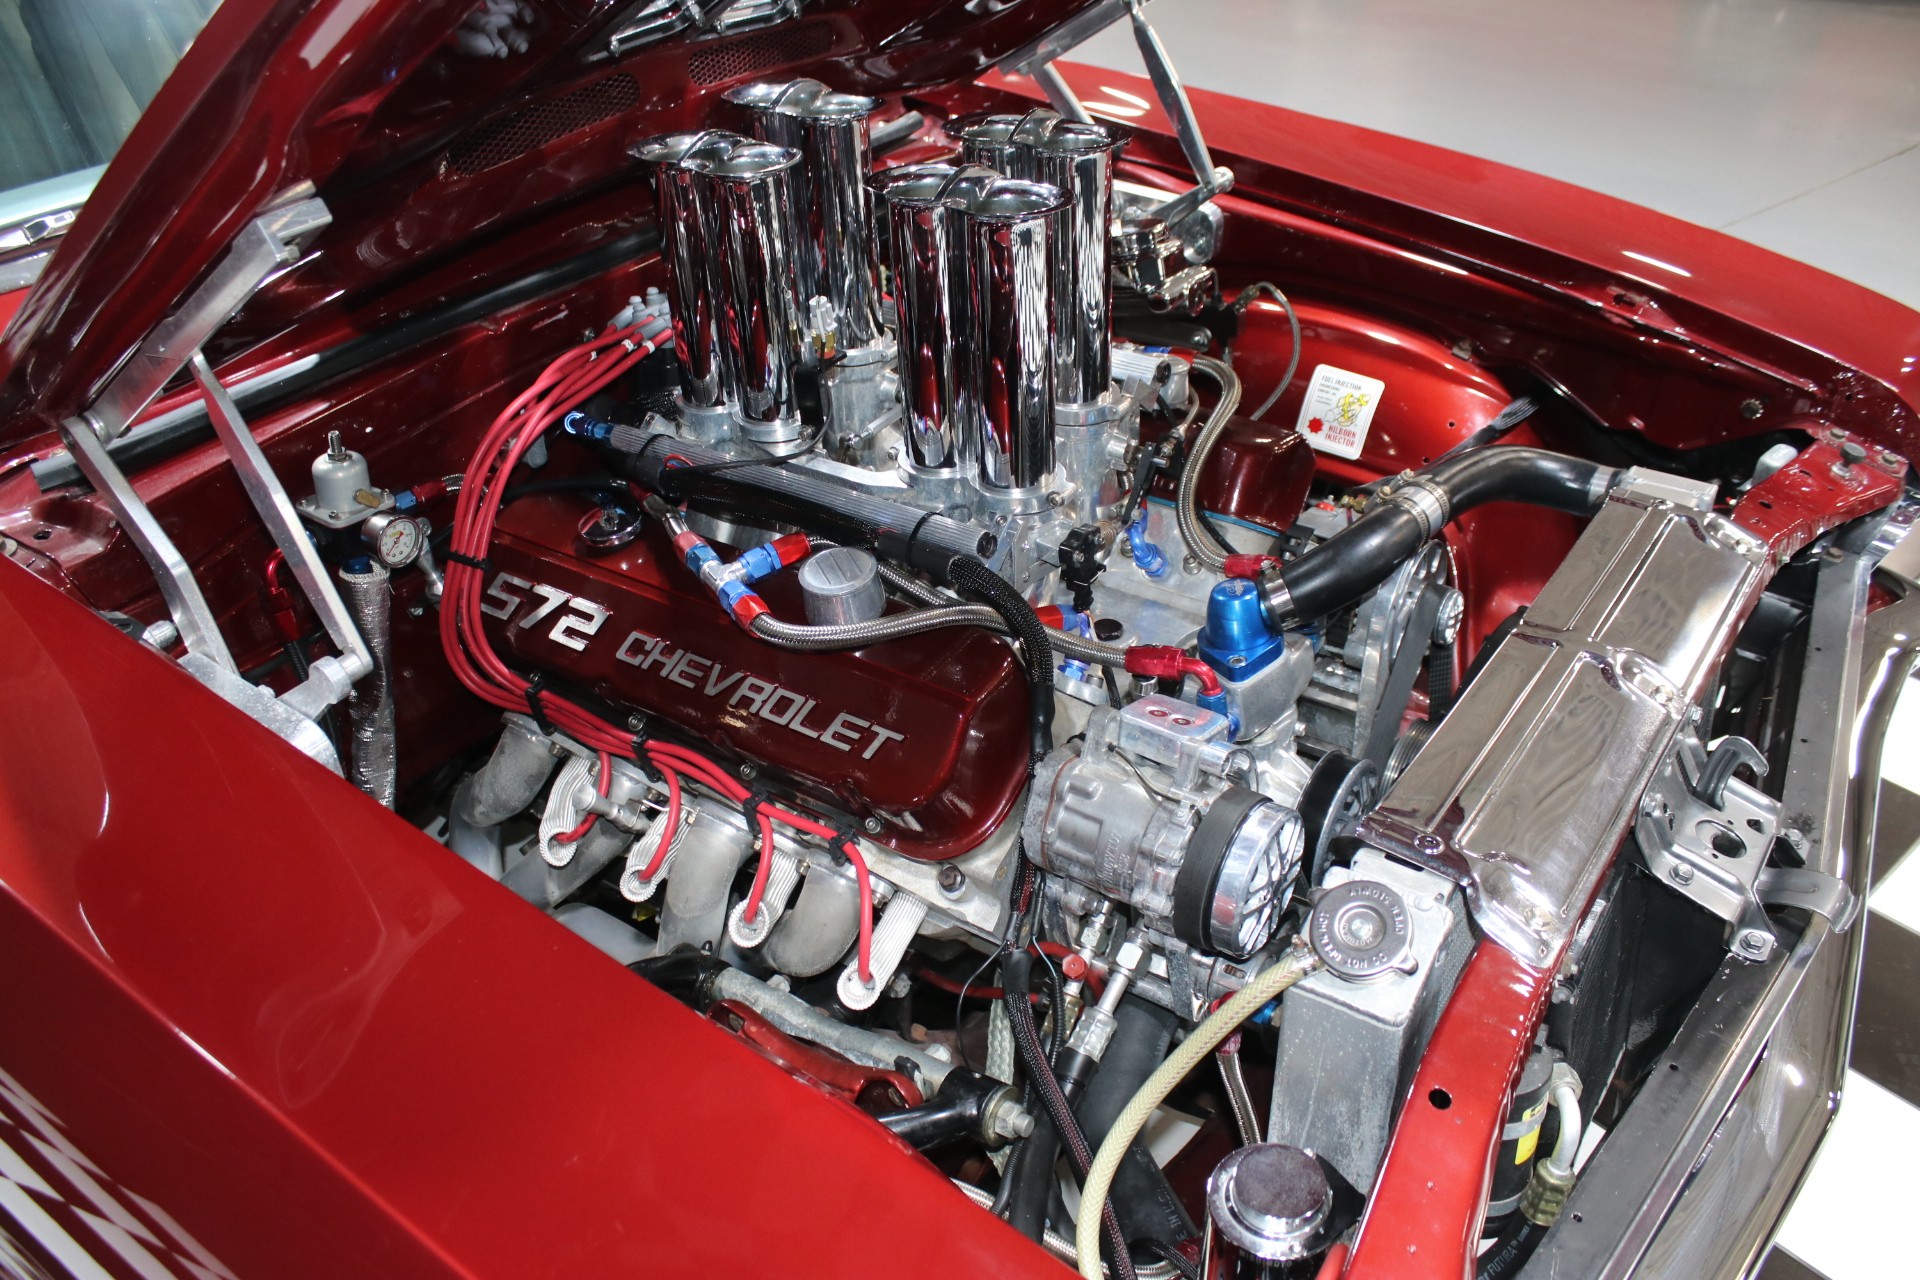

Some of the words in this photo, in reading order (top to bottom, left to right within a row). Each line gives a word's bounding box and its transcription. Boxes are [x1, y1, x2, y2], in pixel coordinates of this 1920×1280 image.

[1334, 378, 1362, 391] INJECTION
[1324, 433, 1356, 448] INJECTOR
[480, 571, 613, 652] 572
[615, 630, 905, 760] CHEVROLET
[1349, 887, 1392, 905] SLOWLY
[1346, 958, 1368, 969] NOT
